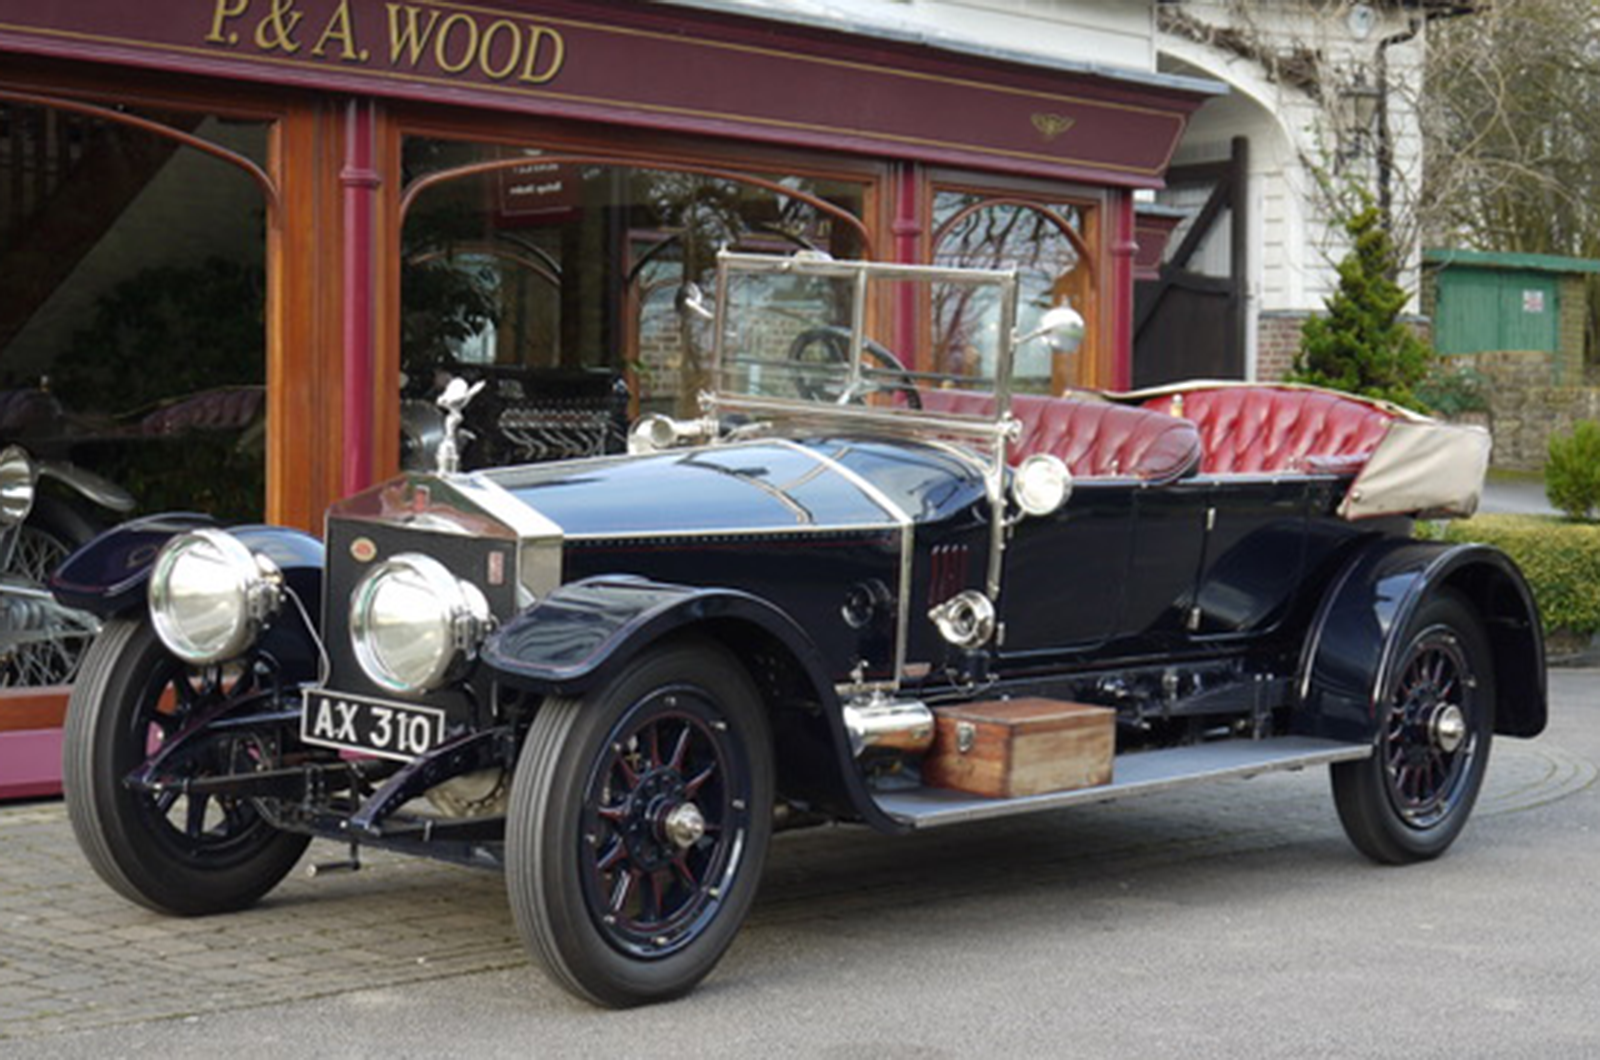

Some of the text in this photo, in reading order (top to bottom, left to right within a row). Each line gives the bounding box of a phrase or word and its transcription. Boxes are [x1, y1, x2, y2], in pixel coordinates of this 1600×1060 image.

[205, 0, 564, 83] P. & A. WOOD
[314, 699, 430, 754] AX 310
